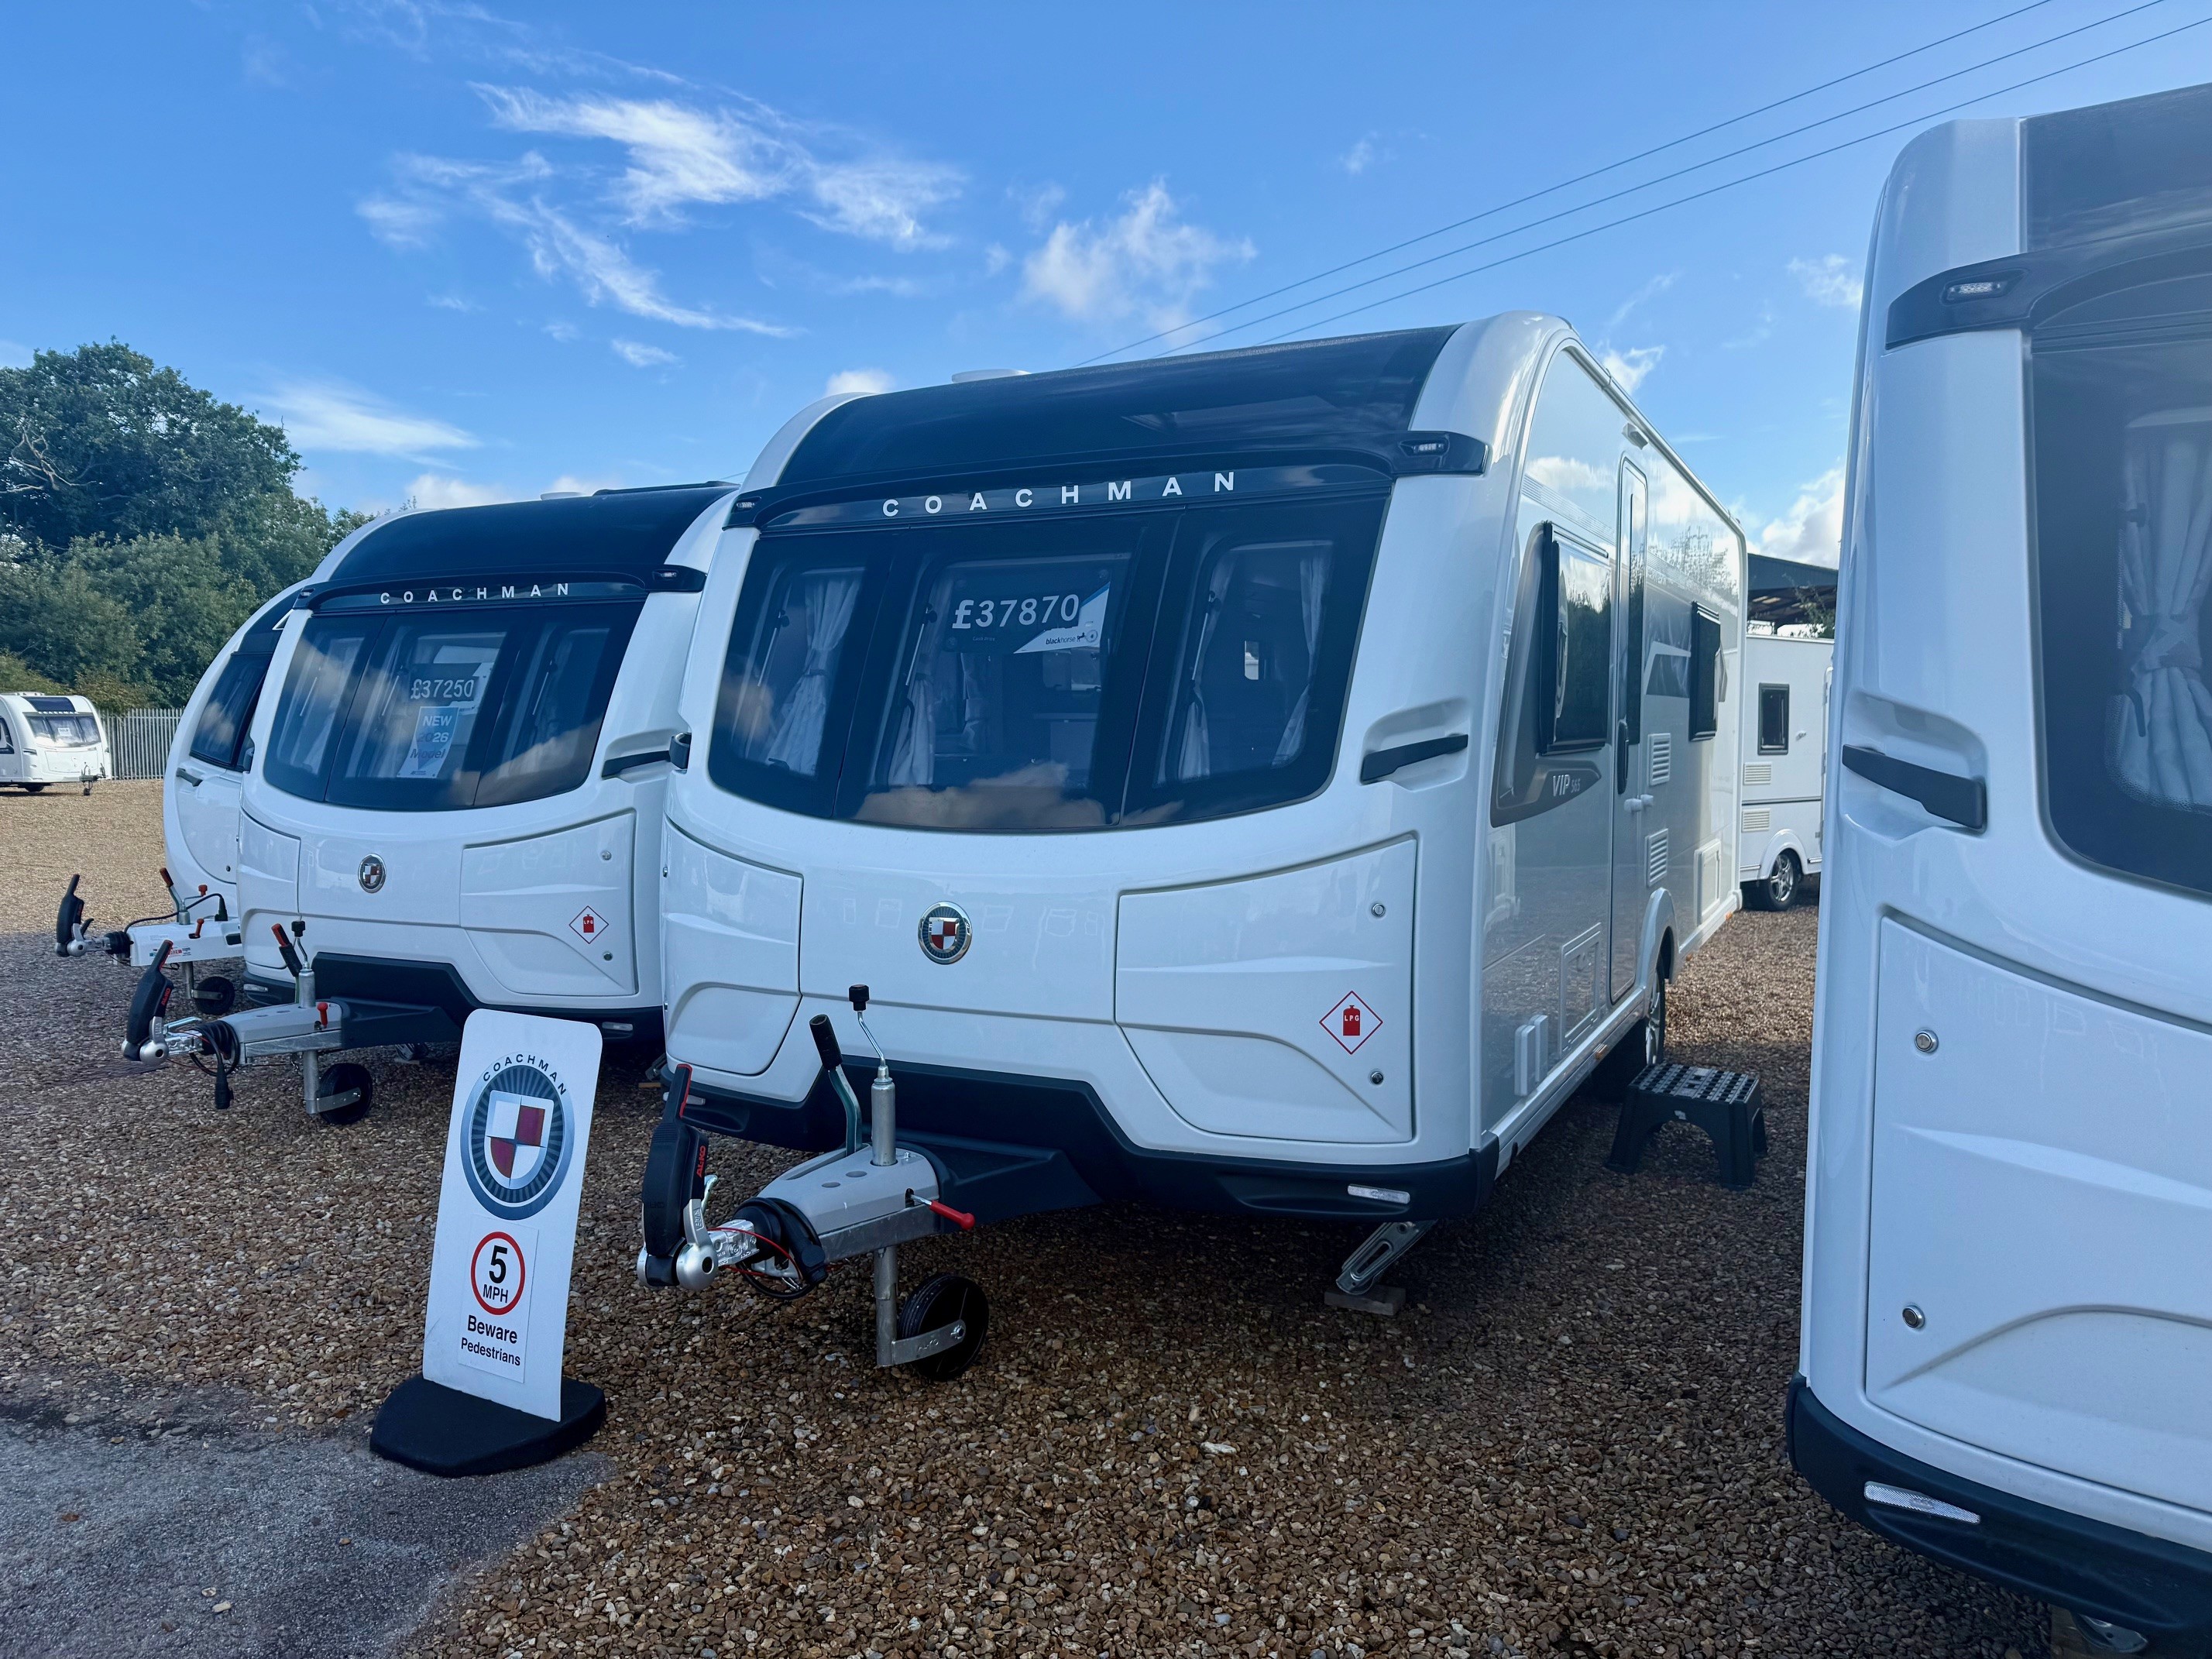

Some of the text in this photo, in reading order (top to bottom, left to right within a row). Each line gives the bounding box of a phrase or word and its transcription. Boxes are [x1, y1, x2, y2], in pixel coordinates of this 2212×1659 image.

[882, 472, 1234, 517] COACHMAN
[380, 583, 568, 604] COACHMAN
[952, 594, 1079, 629] £37870
[1046, 635, 1076, 645] blackhorse
[410, 678, 474, 699] £37250
[422, 716, 452, 726] NEW
[410, 748, 446, 759] Model
[1553, 775, 1570, 797] VIP
[483, 1053, 566, 1096] COACHMAN
[489, 1245, 508, 1283] 5
[483, 1283, 509, 1304] MPH
[467, 1314, 517, 1344] Beware
[461, 1337, 520, 1366] Pedestrians
